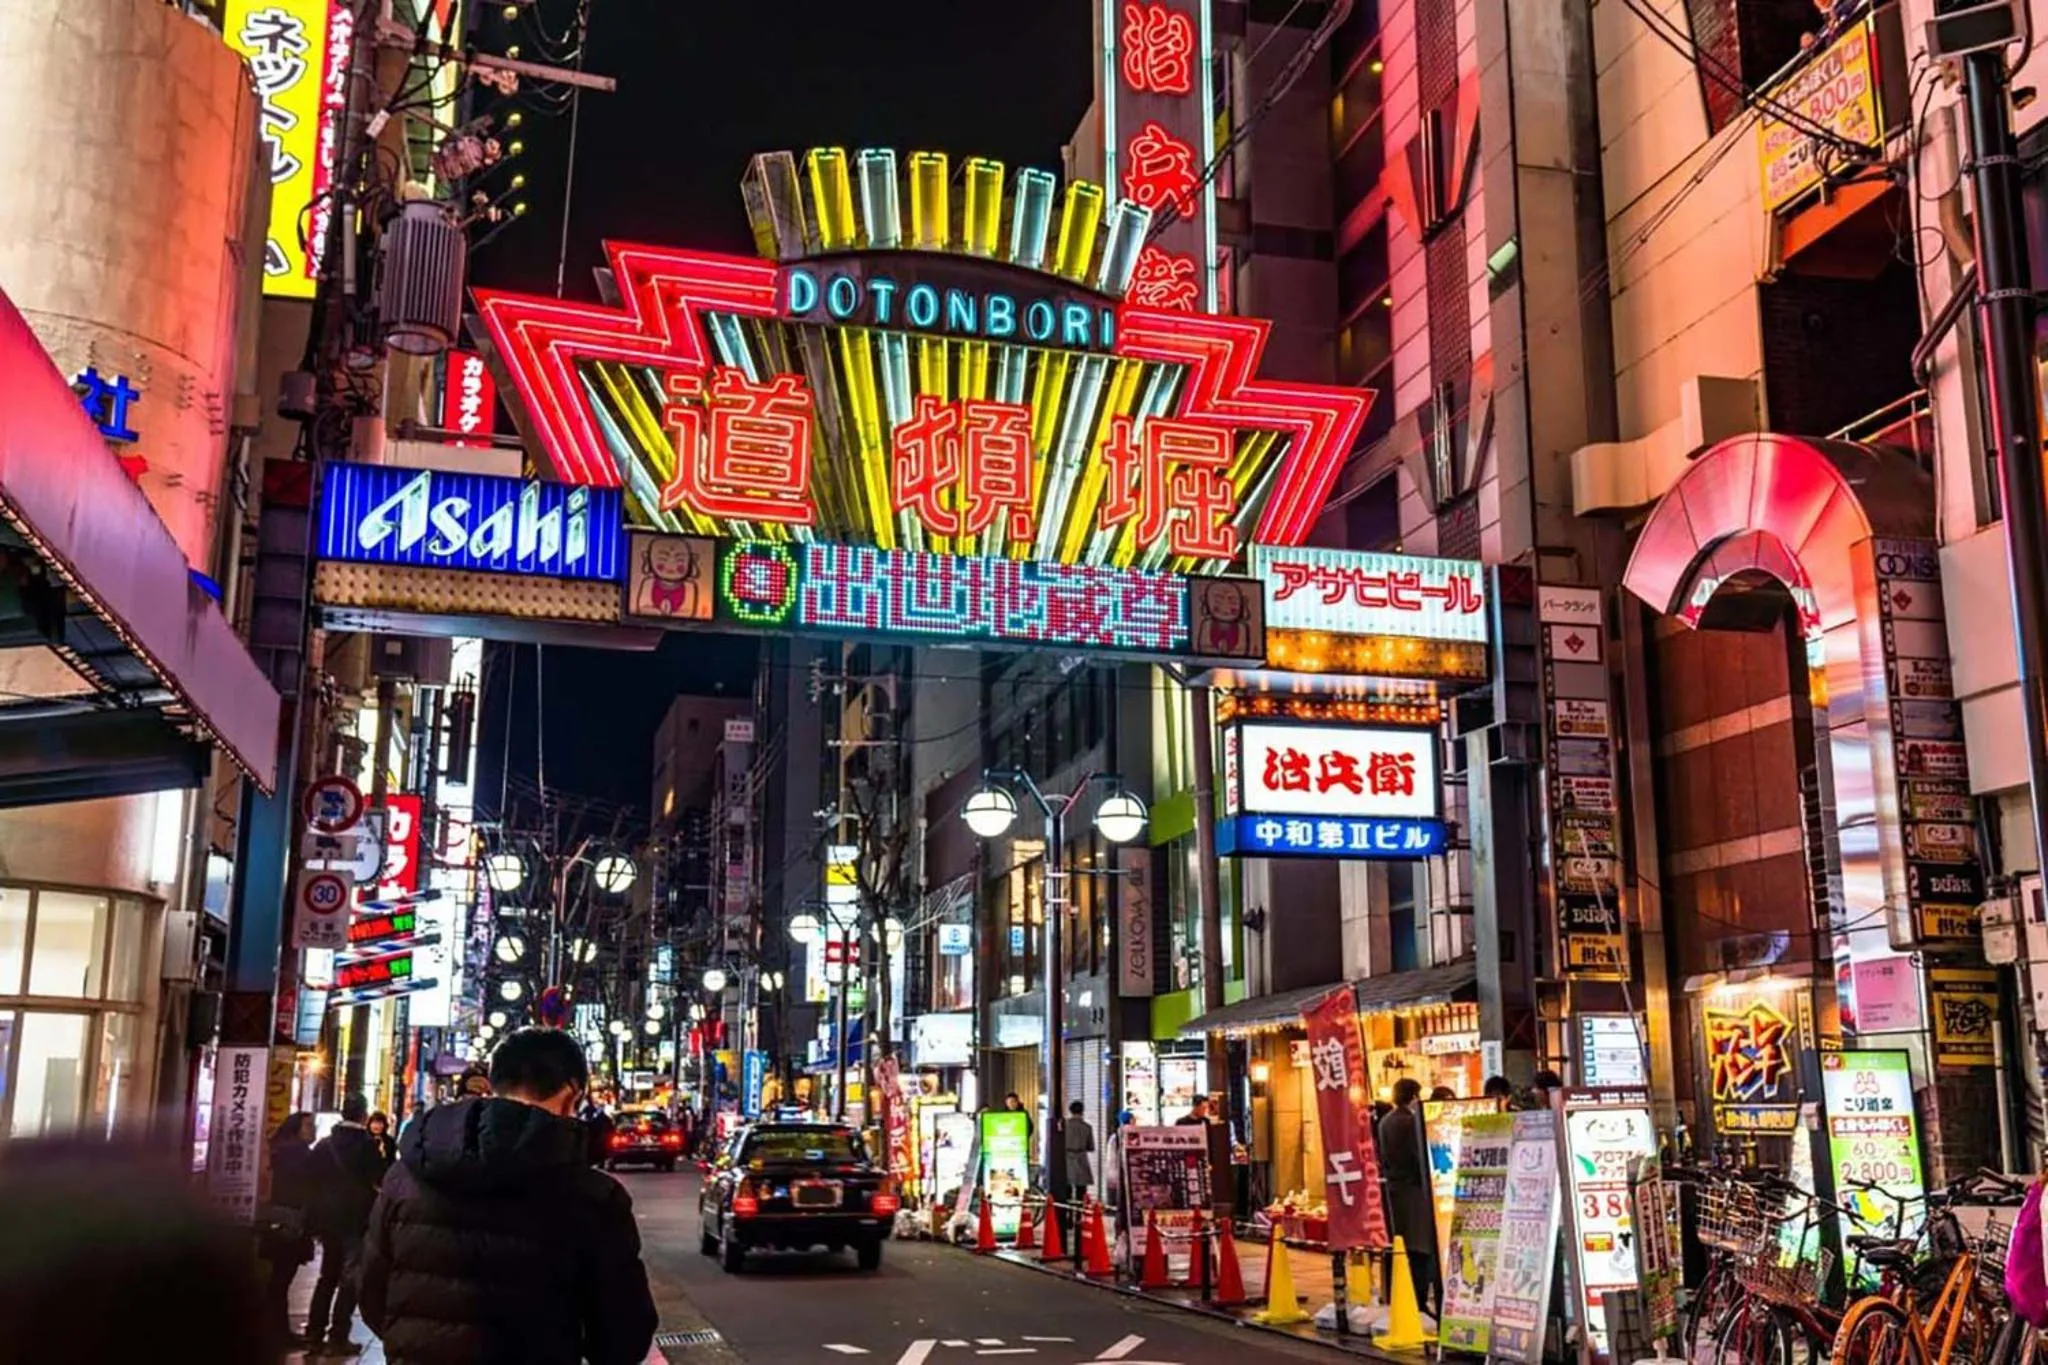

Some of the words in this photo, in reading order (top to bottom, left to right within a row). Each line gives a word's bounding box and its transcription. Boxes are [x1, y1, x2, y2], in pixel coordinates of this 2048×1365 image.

[789, 268, 1115, 348] DOTONBORI
[458, 356, 484, 433] カラオケ
[658, 366, 1238, 560] 道頓堀
[357, 470, 590, 566] Asahi
[801, 543, 1190, 649] 出世地蔵尊
[1270, 562, 1483, 613] アサヒビール
[1262, 745, 1416, 797] 治兵衛
[313, 885, 337, 903] 30
[225, 1053, 251, 1175] 防犯カメラ作動中
[1843, 1097, 1894, 1112] こり道楽
